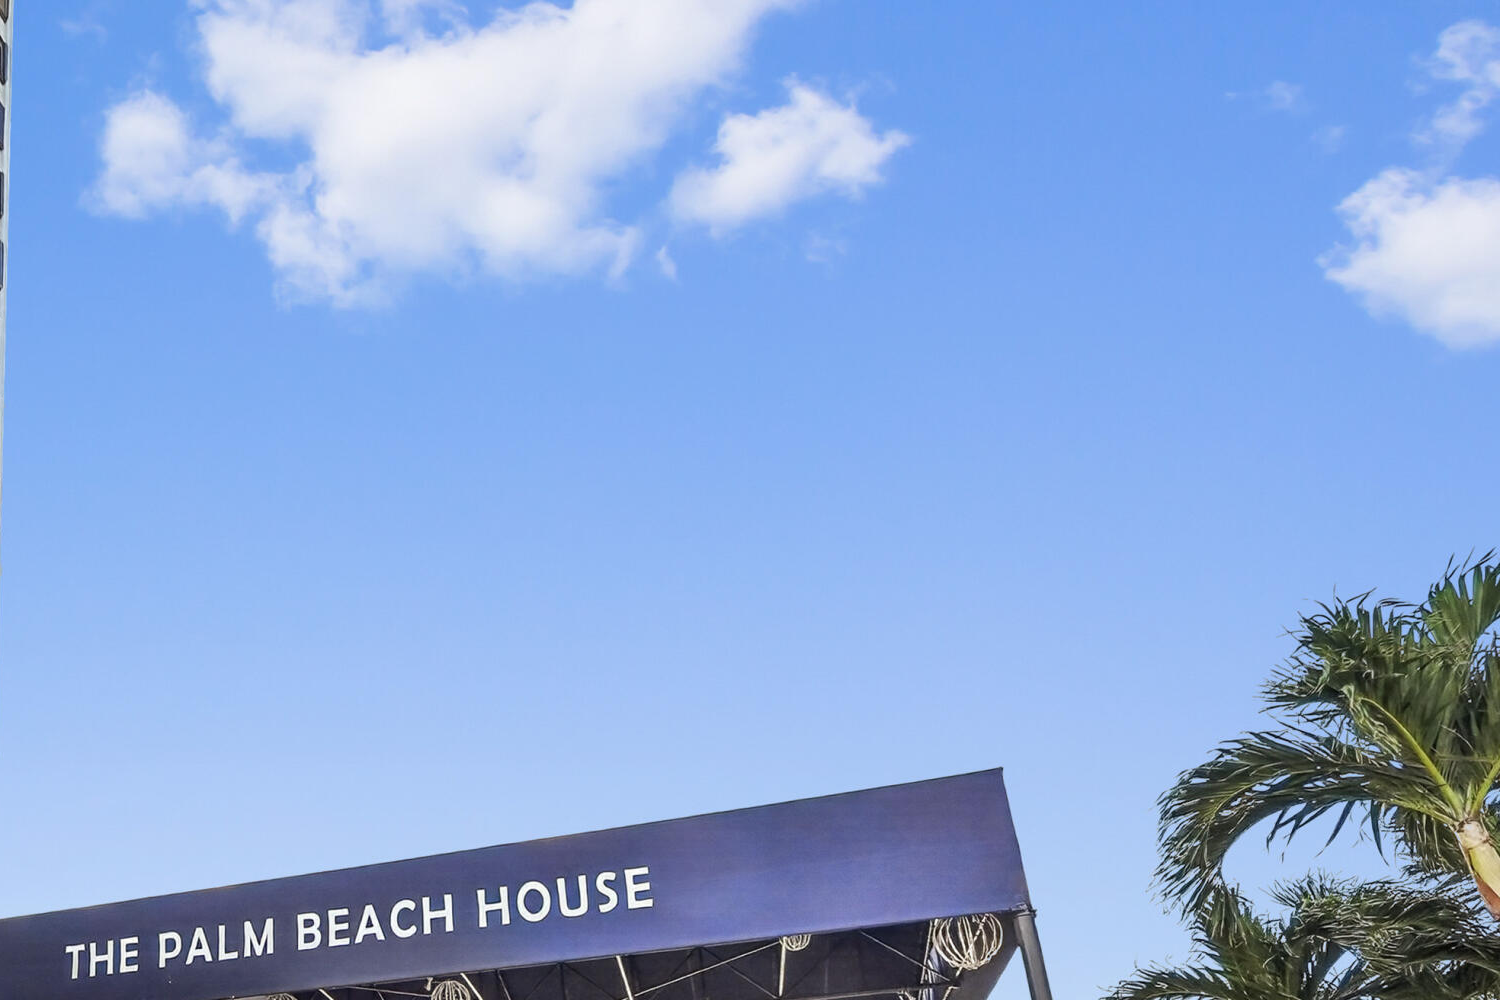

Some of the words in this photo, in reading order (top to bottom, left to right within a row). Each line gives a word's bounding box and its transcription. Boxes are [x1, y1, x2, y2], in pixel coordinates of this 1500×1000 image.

[65, 936, 140, 979] THE
[157, 918, 275, 968] PALM
[296, 894, 454, 951] BEACH
[476, 866, 655, 928] HOUSE
